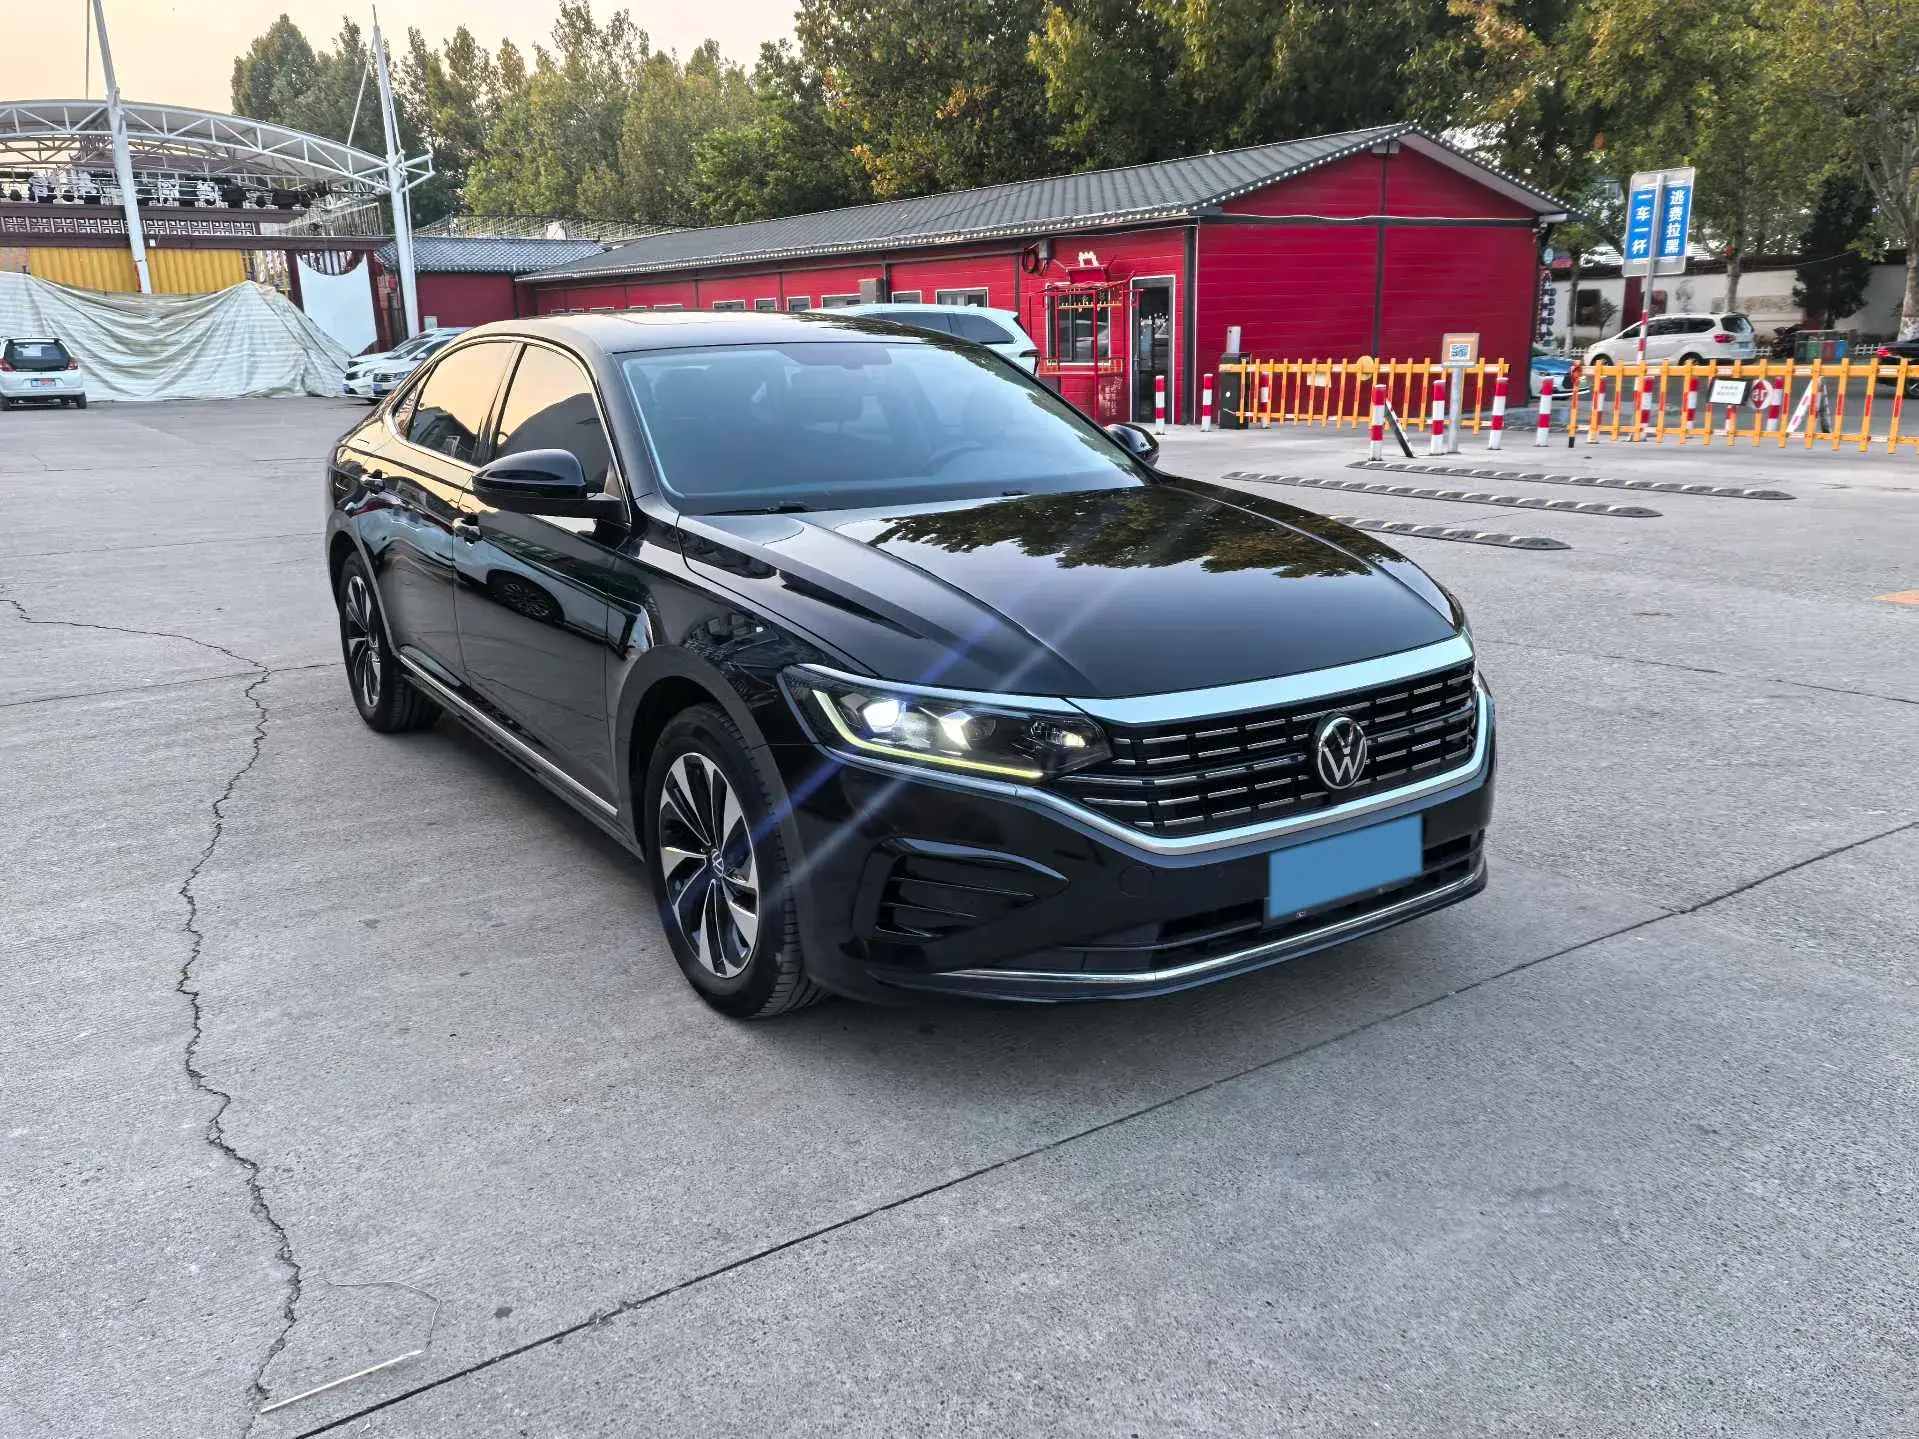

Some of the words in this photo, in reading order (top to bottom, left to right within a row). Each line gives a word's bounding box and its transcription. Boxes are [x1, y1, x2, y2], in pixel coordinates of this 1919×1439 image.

[1631, 194, 1653, 254] 一车一杆
[1664, 190, 1685, 254] 逃费拉黑
